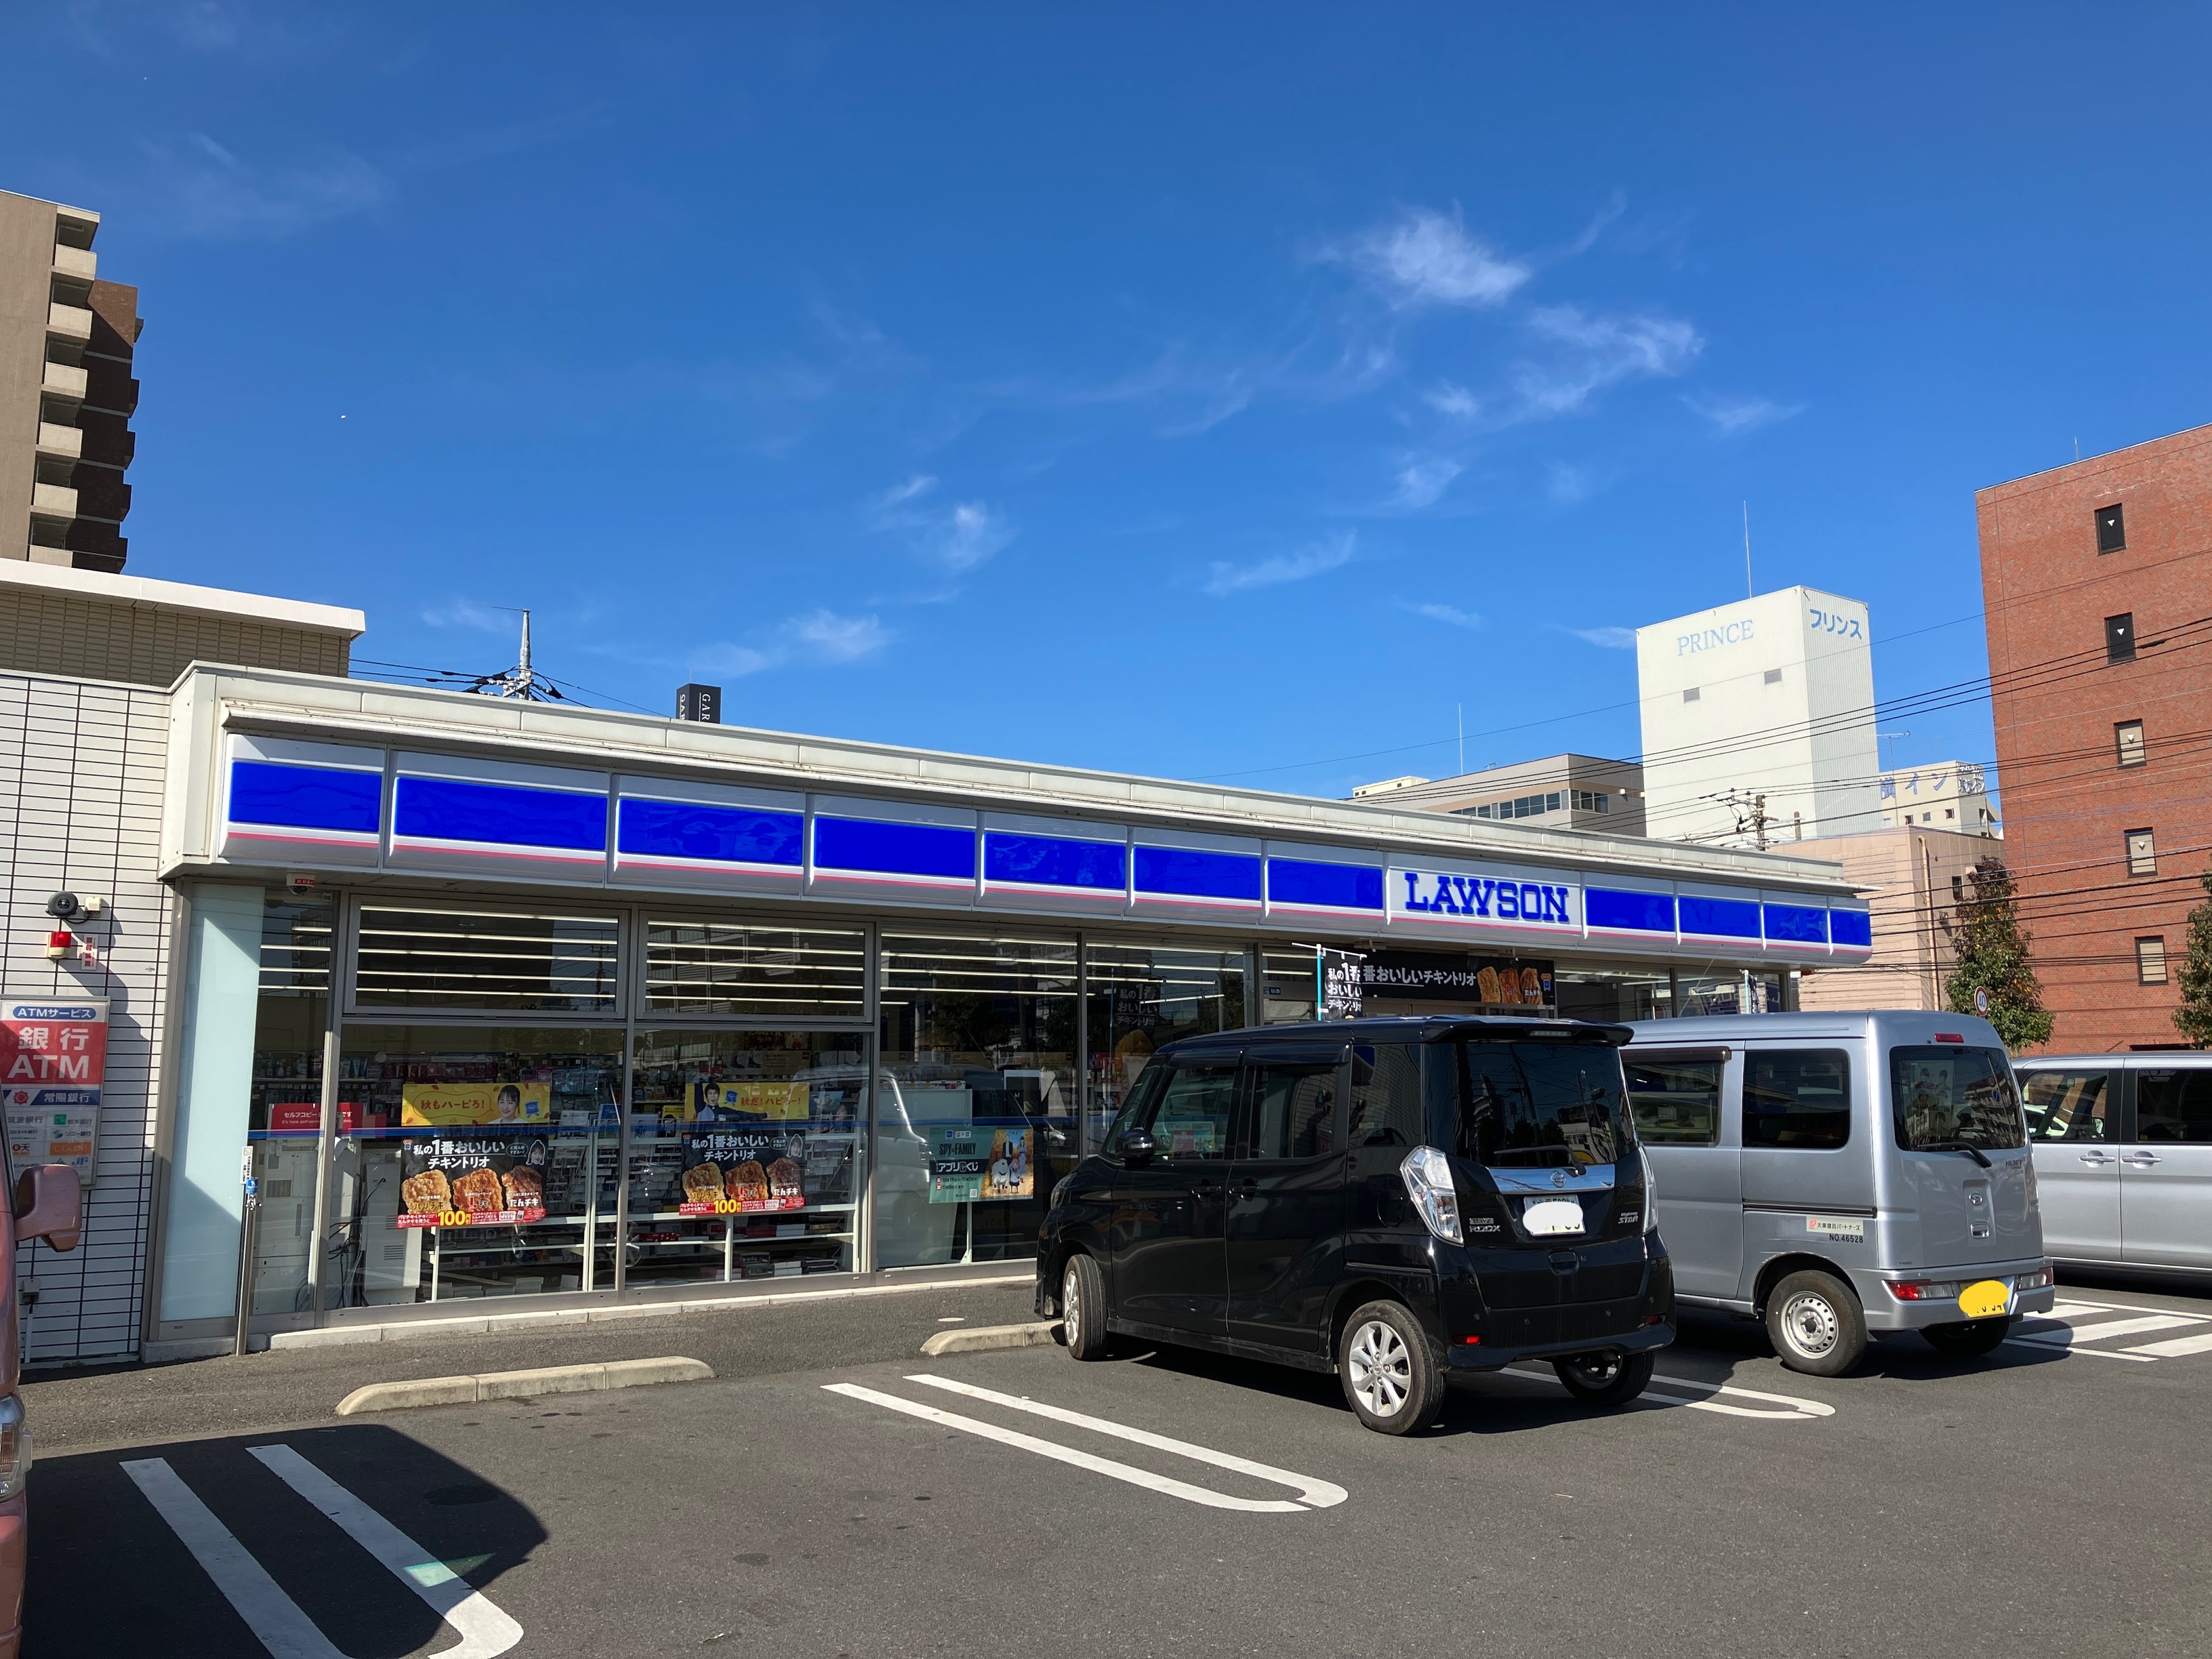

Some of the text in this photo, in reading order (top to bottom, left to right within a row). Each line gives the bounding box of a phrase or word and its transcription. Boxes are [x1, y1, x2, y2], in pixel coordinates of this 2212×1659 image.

[1677, 619, 1755, 657] PRINCE
[1404, 872, 1569, 922] LAWSON
[1328, 962, 1361, 982] 私の1番
[1328, 982, 1362, 998] おいしい
[1978, 995, 1986, 1008] 40
[18, 1008, 91, 1018] ATMサービス
[18, 1026, 89, 1050] 銀行
[7, 1054, 89, 1079] ATM
[44, 1092, 90, 1103] 常陽銀行
[413, 1139, 506, 1155] 私の1番おいしい
[691, 1134, 769, 1149] 私の1番おいしい
[704, 1149, 756, 1162] チキントリオ
[428, 1156, 490, 1170] チキントリオ
[693, 1191, 718, 1200] パリチキ
[773, 1187, 798, 1196] たんチキ
[413, 1202, 444, 1210] パリチキ
[510, 1198, 539, 1207] たんチキ
[713, 1199, 737, 1214] 100
[438, 1210, 466, 1226] 100
[1618, 1216, 1639, 1225] STAR
[1469, 1225, 1501, 1233] ROOX
[1818, 1222, 1861, 1231] 大東建託パートナーズ
[1830, 1233, 1864, 1244] NO.46528
